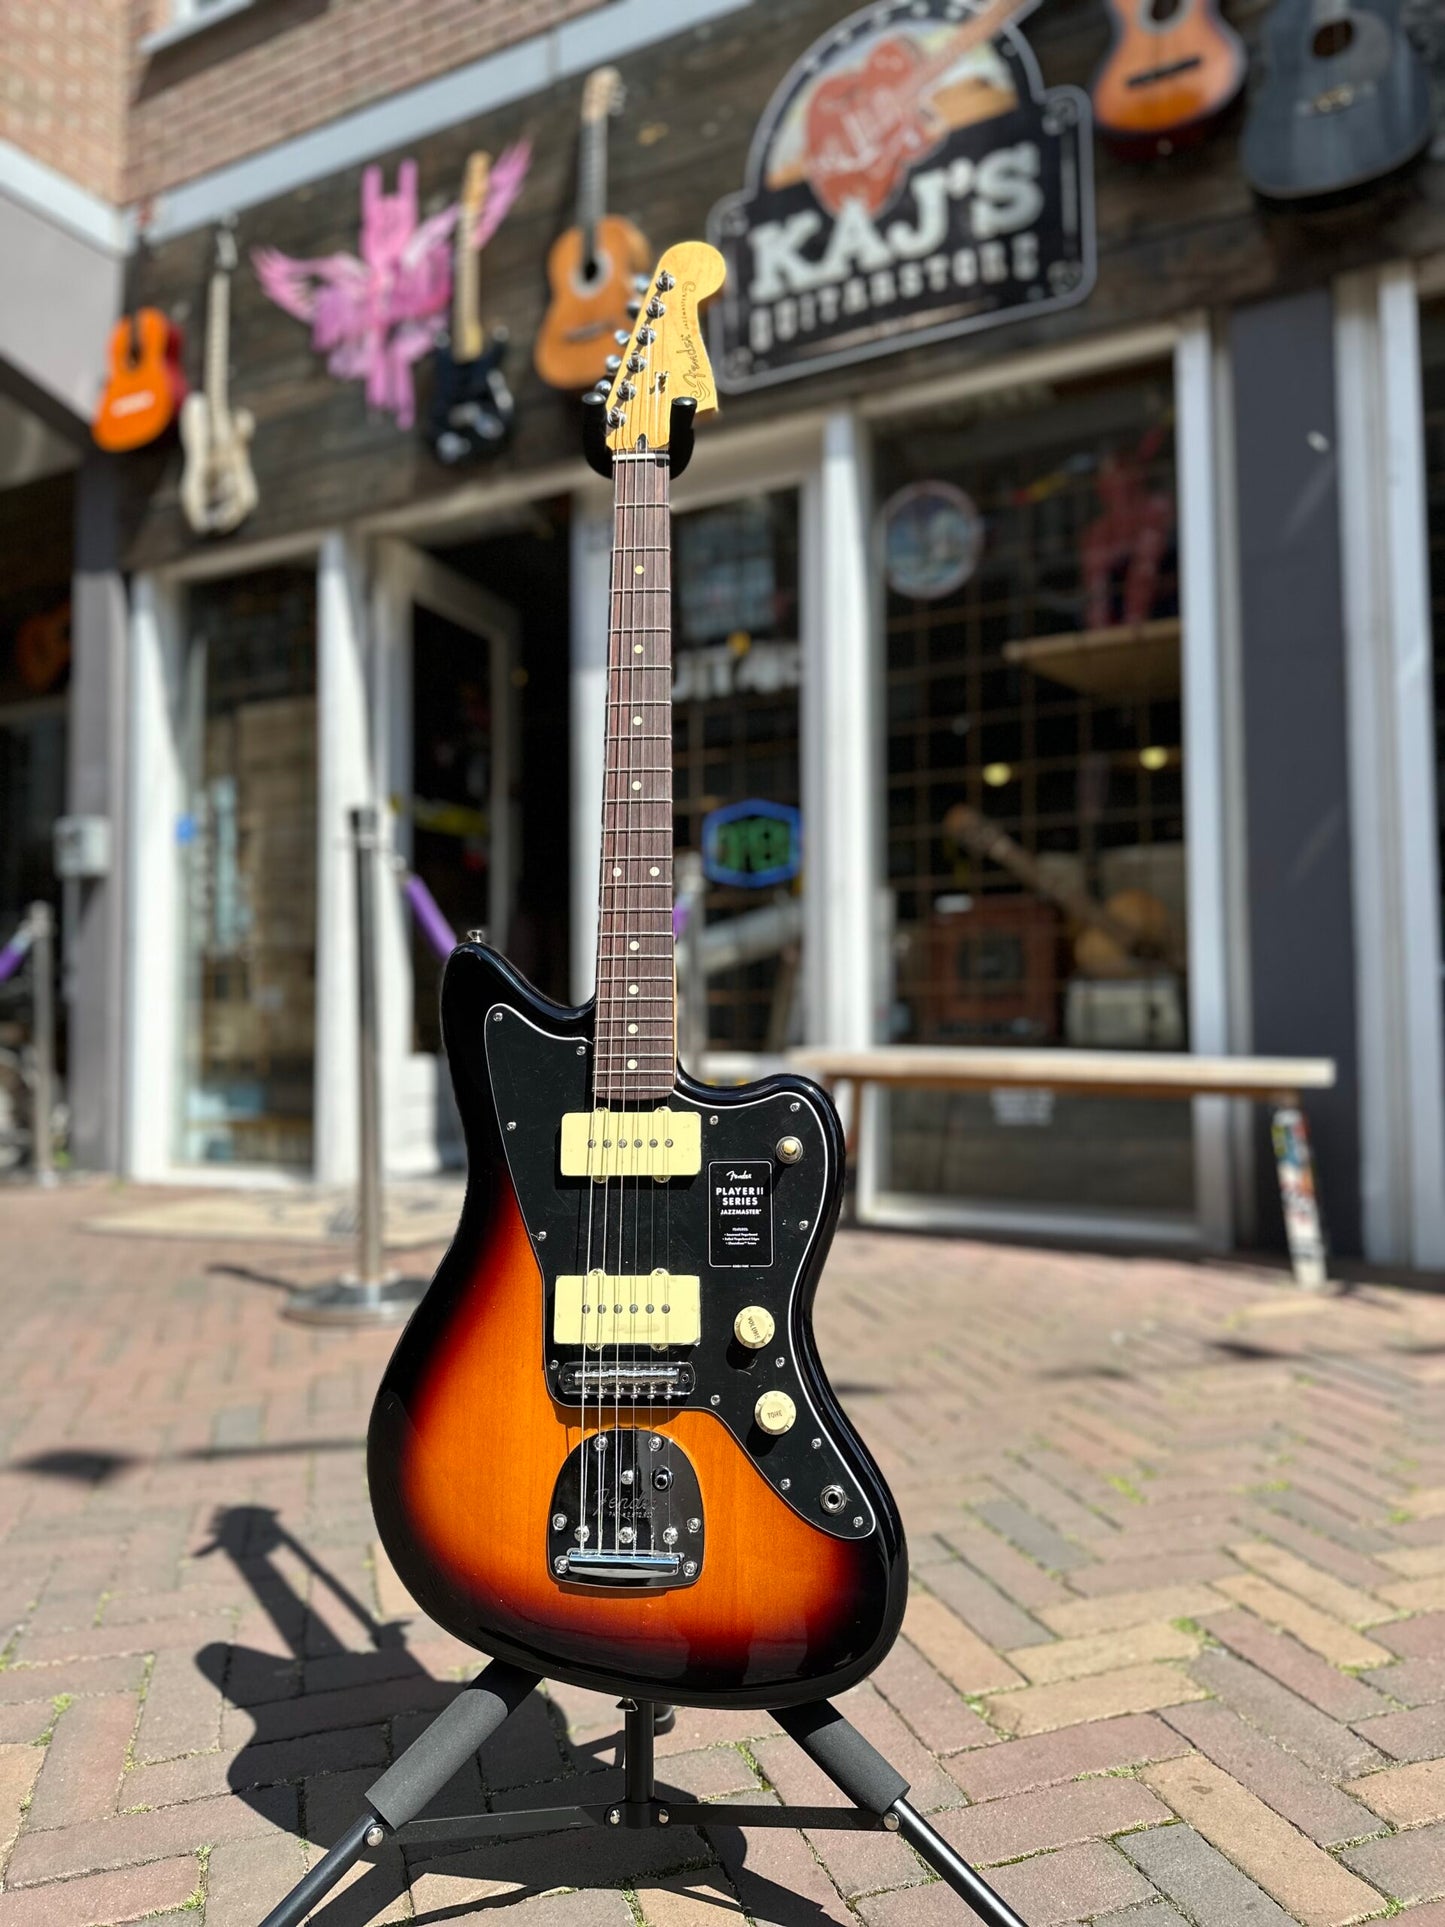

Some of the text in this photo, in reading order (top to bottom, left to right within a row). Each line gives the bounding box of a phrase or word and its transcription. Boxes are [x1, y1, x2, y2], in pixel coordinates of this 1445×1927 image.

[747, 142, 1043, 300] KAJ'S
[749, 234, 1040, 353] GUITARSTORE
[676, 334, 706, 389] Fender
[726, 1170, 752, 1181] Fender
[715, 1187, 756, 1196] PLAYER
[722, 1197, 759, 1206] SERIES
[746, 1316, 761, 1340] VOLUME
[766, 1409, 783, 1419] TONE
